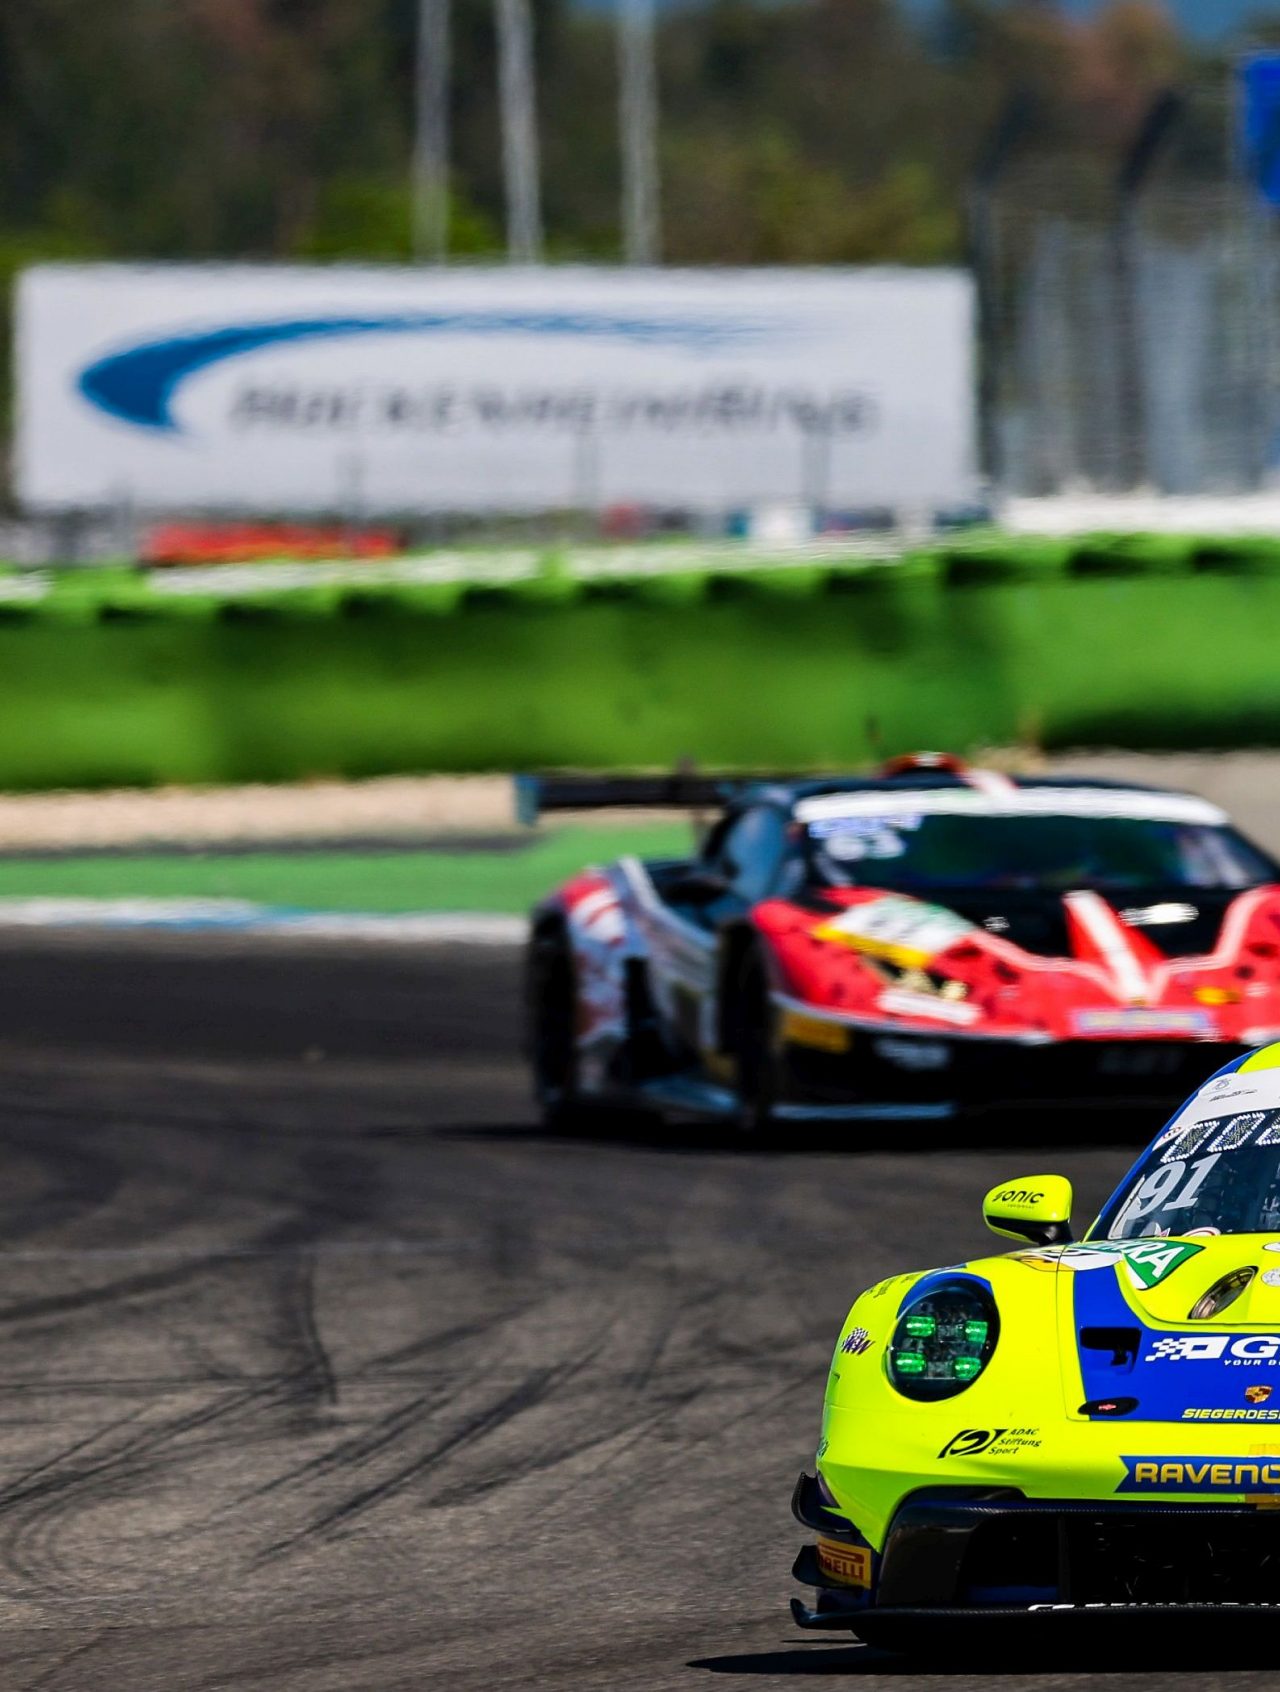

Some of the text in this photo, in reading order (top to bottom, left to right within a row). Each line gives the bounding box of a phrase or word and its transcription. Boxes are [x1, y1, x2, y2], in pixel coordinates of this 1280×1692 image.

[1131, 1153, 1222, 1220] 91
[1010, 1428, 1040, 1436] ADAC
[998, 1437, 1042, 1448] Stiftung
[988, 1447, 1019, 1455] Sport
